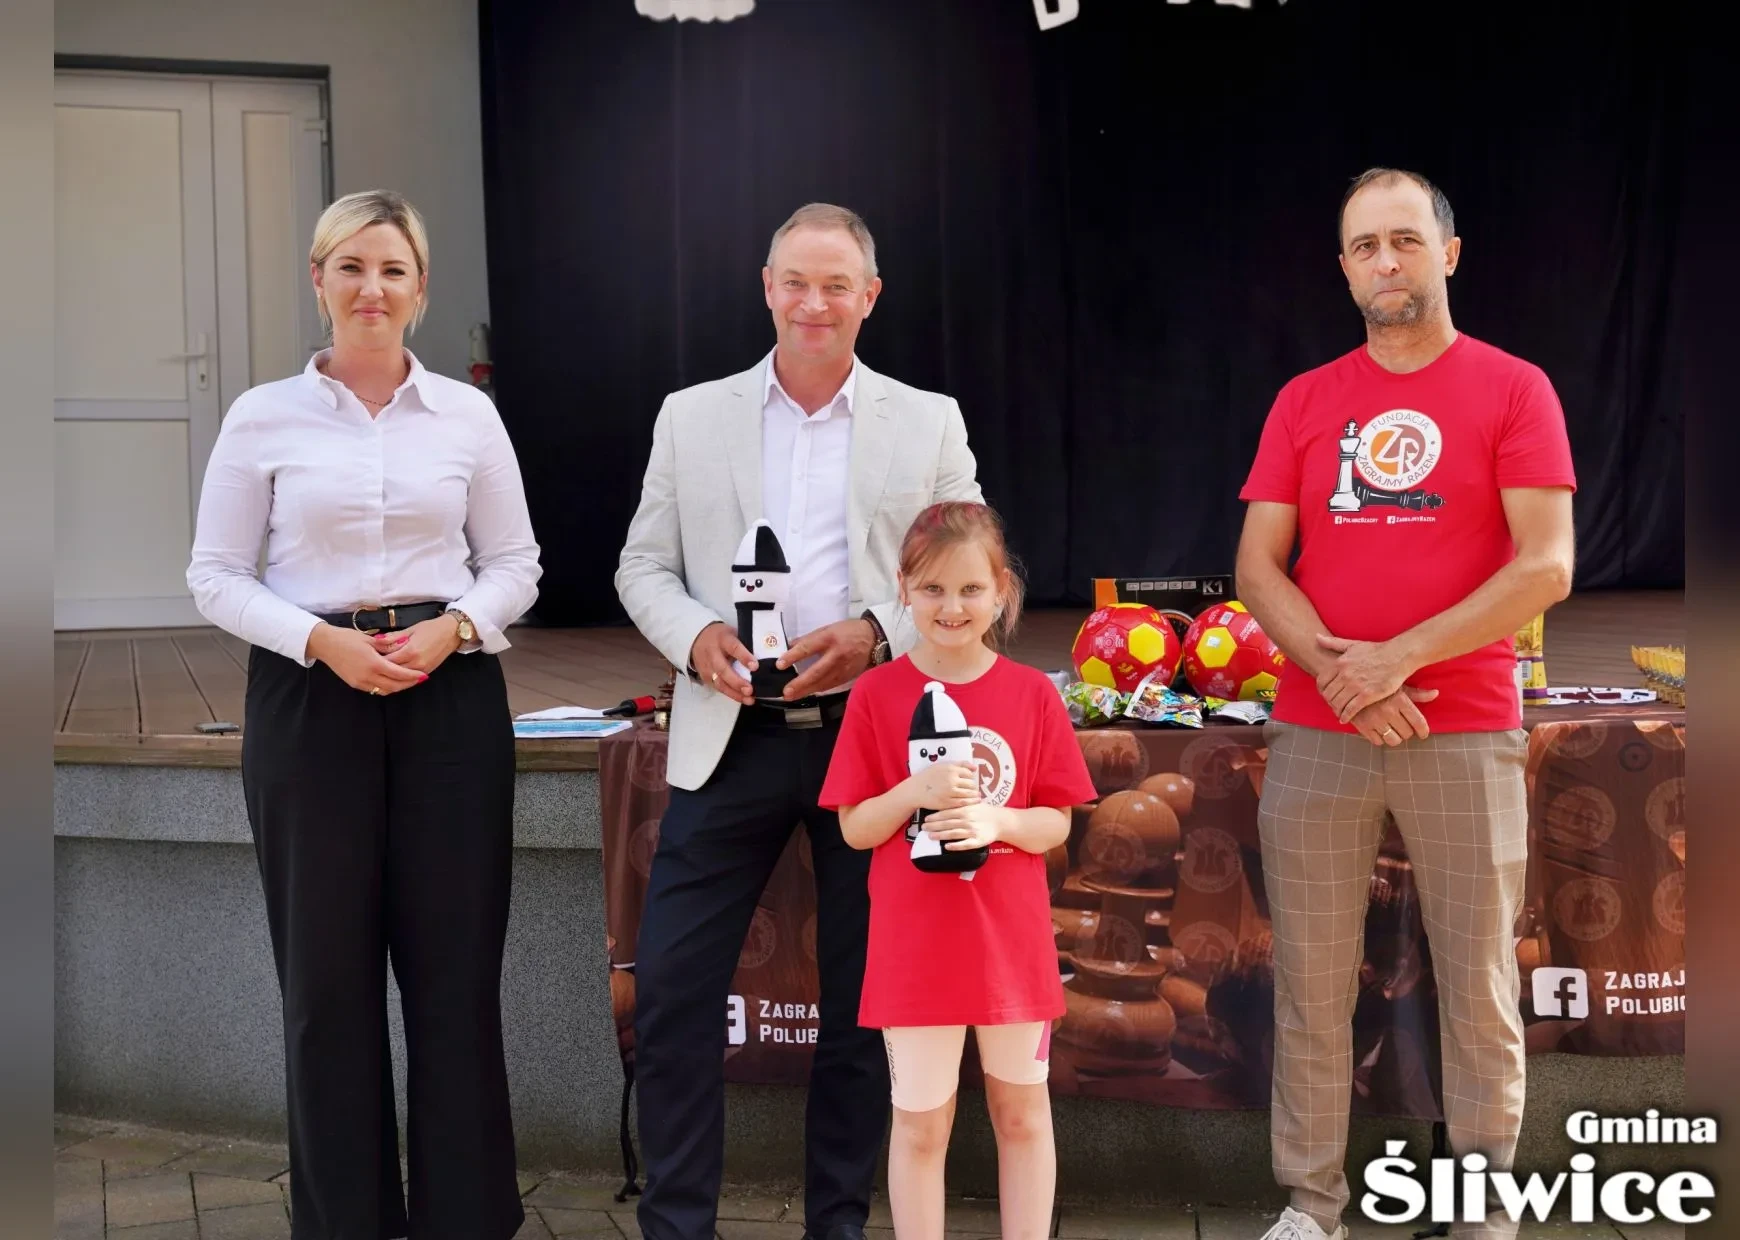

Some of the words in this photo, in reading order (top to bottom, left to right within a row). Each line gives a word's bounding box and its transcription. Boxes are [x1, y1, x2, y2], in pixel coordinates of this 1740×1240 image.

[1371, 412, 1431, 430] FUNDACJA
[1358, 454, 1404, 487] ZAGRAJMY
[1408, 453, 1436, 484] RAZEM
[1203, 580, 1223, 594] K1
[988, 780, 1011, 806] AZEM
